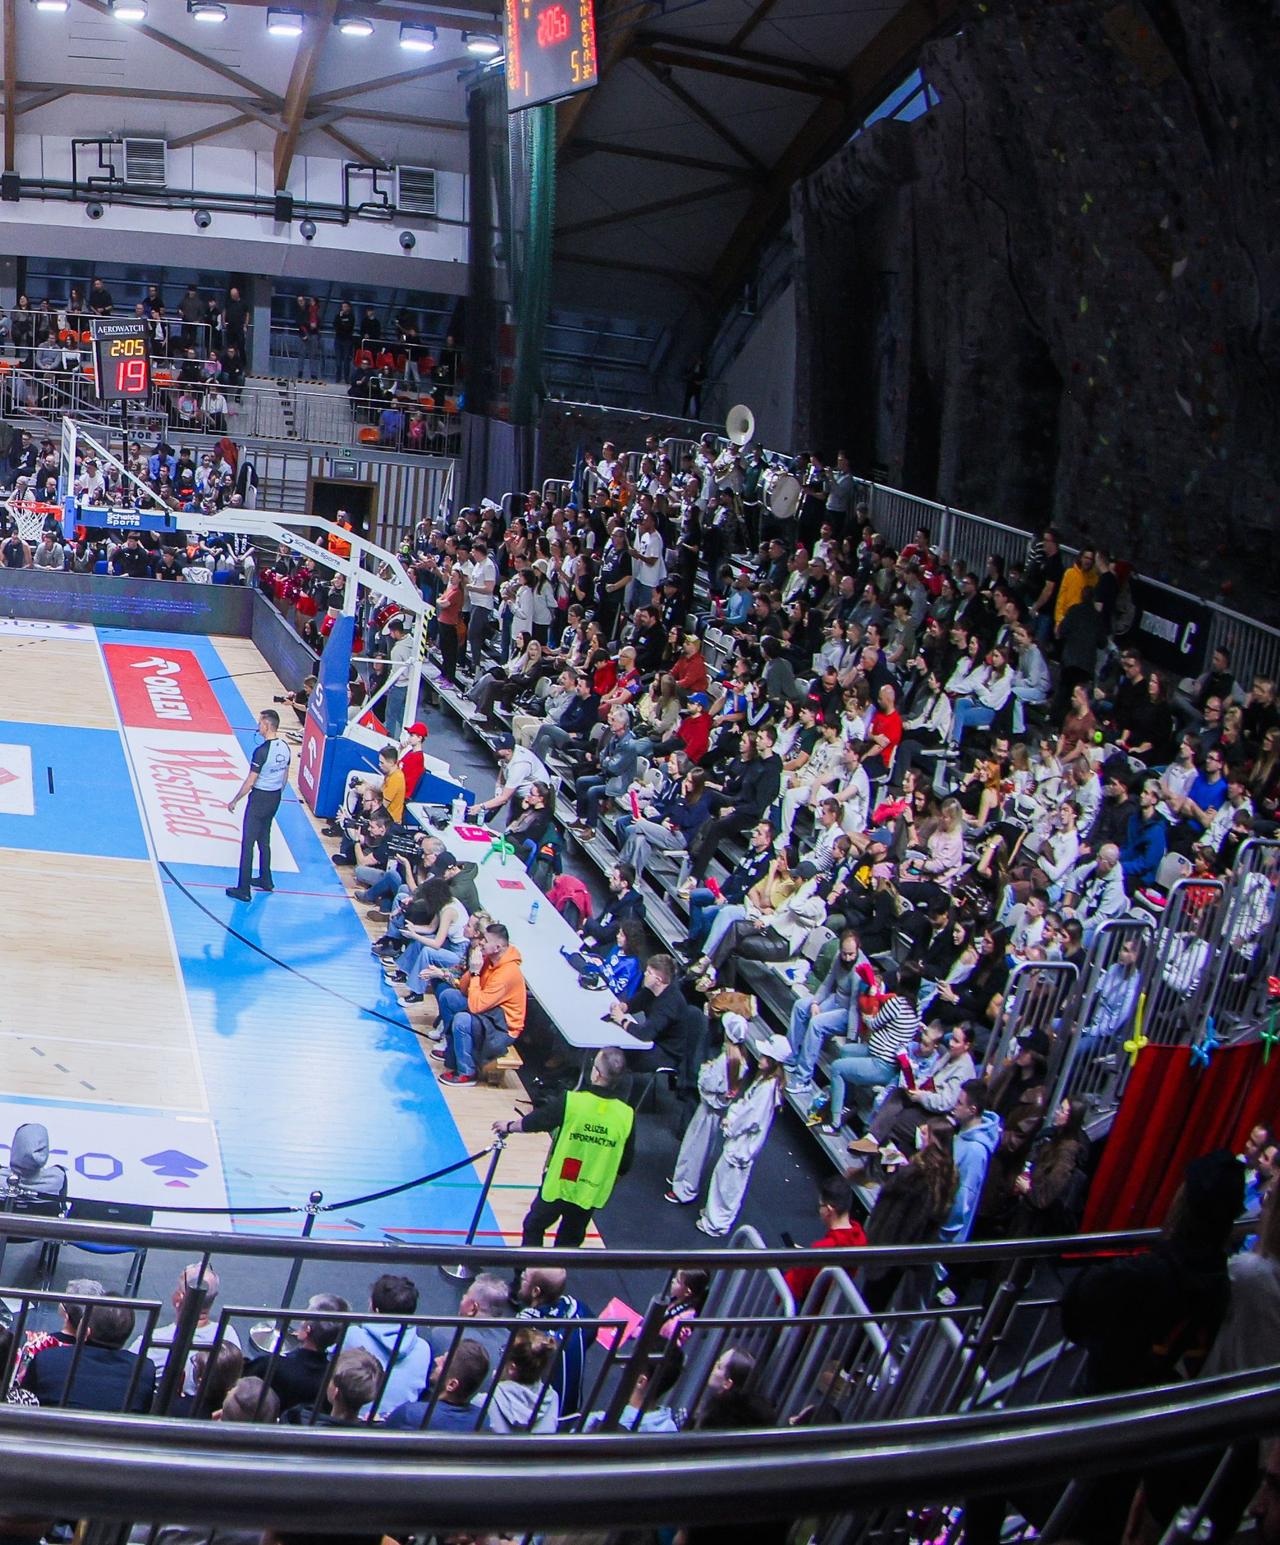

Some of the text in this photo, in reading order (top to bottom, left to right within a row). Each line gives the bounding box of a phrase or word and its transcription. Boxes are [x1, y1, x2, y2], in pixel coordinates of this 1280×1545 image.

[97, 324, 144, 335] AEROWATCH
[111, 340, 144, 356] 2:05
[119, 361, 145, 391] 19
[1180, 621, 1197, 654] C
[147, 677, 192, 721] ORLEN
[143, 745, 242, 845] Westfield
